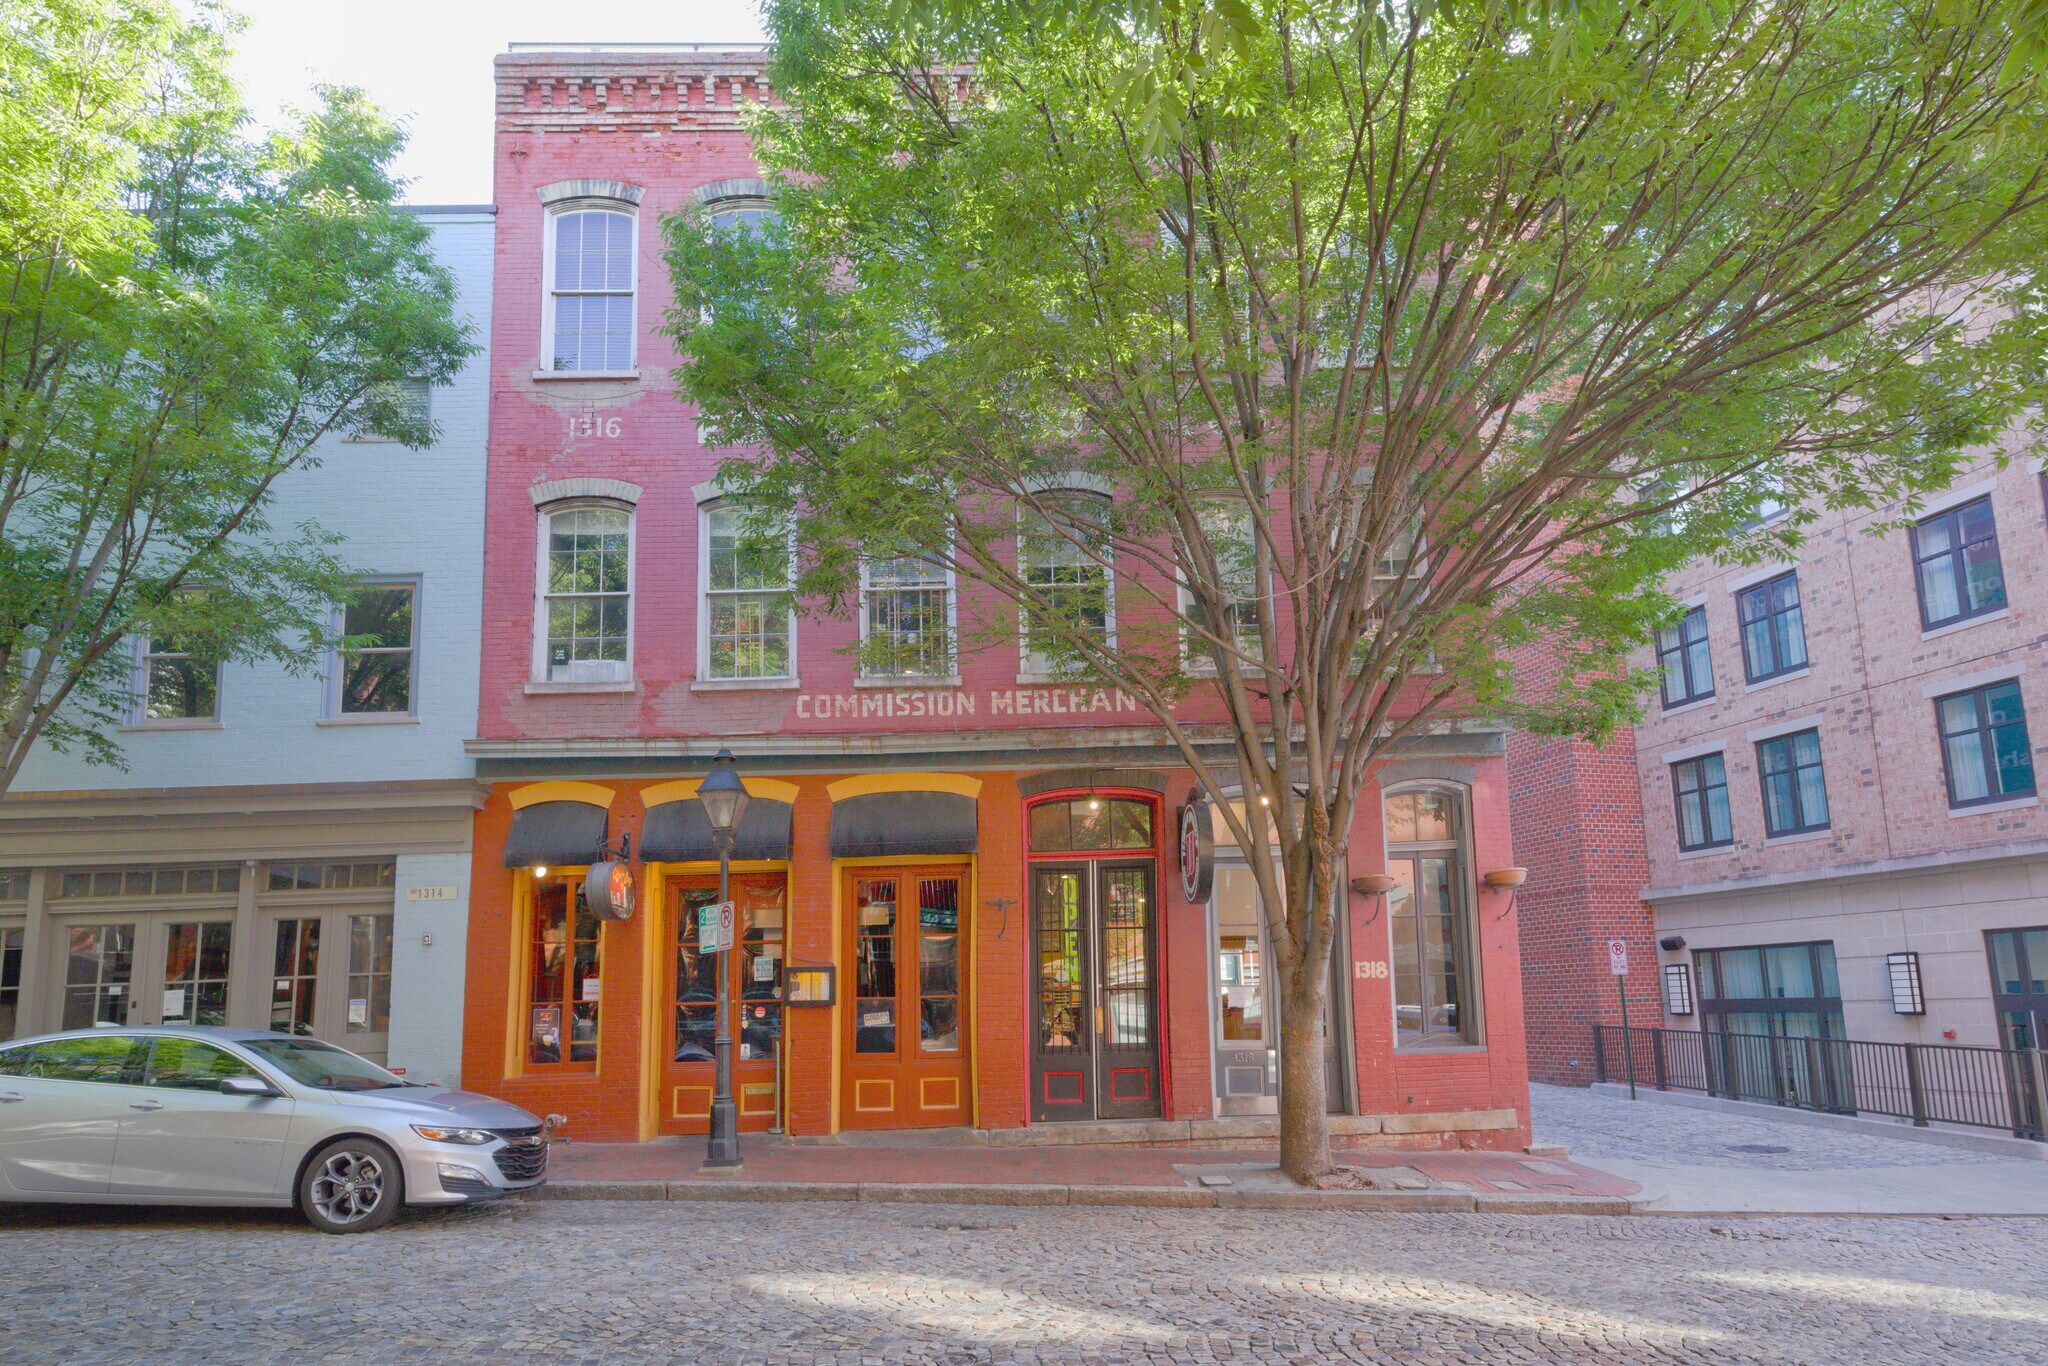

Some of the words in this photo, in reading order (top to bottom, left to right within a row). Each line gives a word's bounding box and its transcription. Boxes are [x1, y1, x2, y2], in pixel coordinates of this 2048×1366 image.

[569, 416, 622, 439] 1316
[796, 691, 976, 718] COMMISSION
[418, 888, 442, 899] 1314
[1063, 878, 1079, 981] OPEN
[1355, 961, 1388, 978] 1318
[1234, 1052, 1255, 1063] 1318
